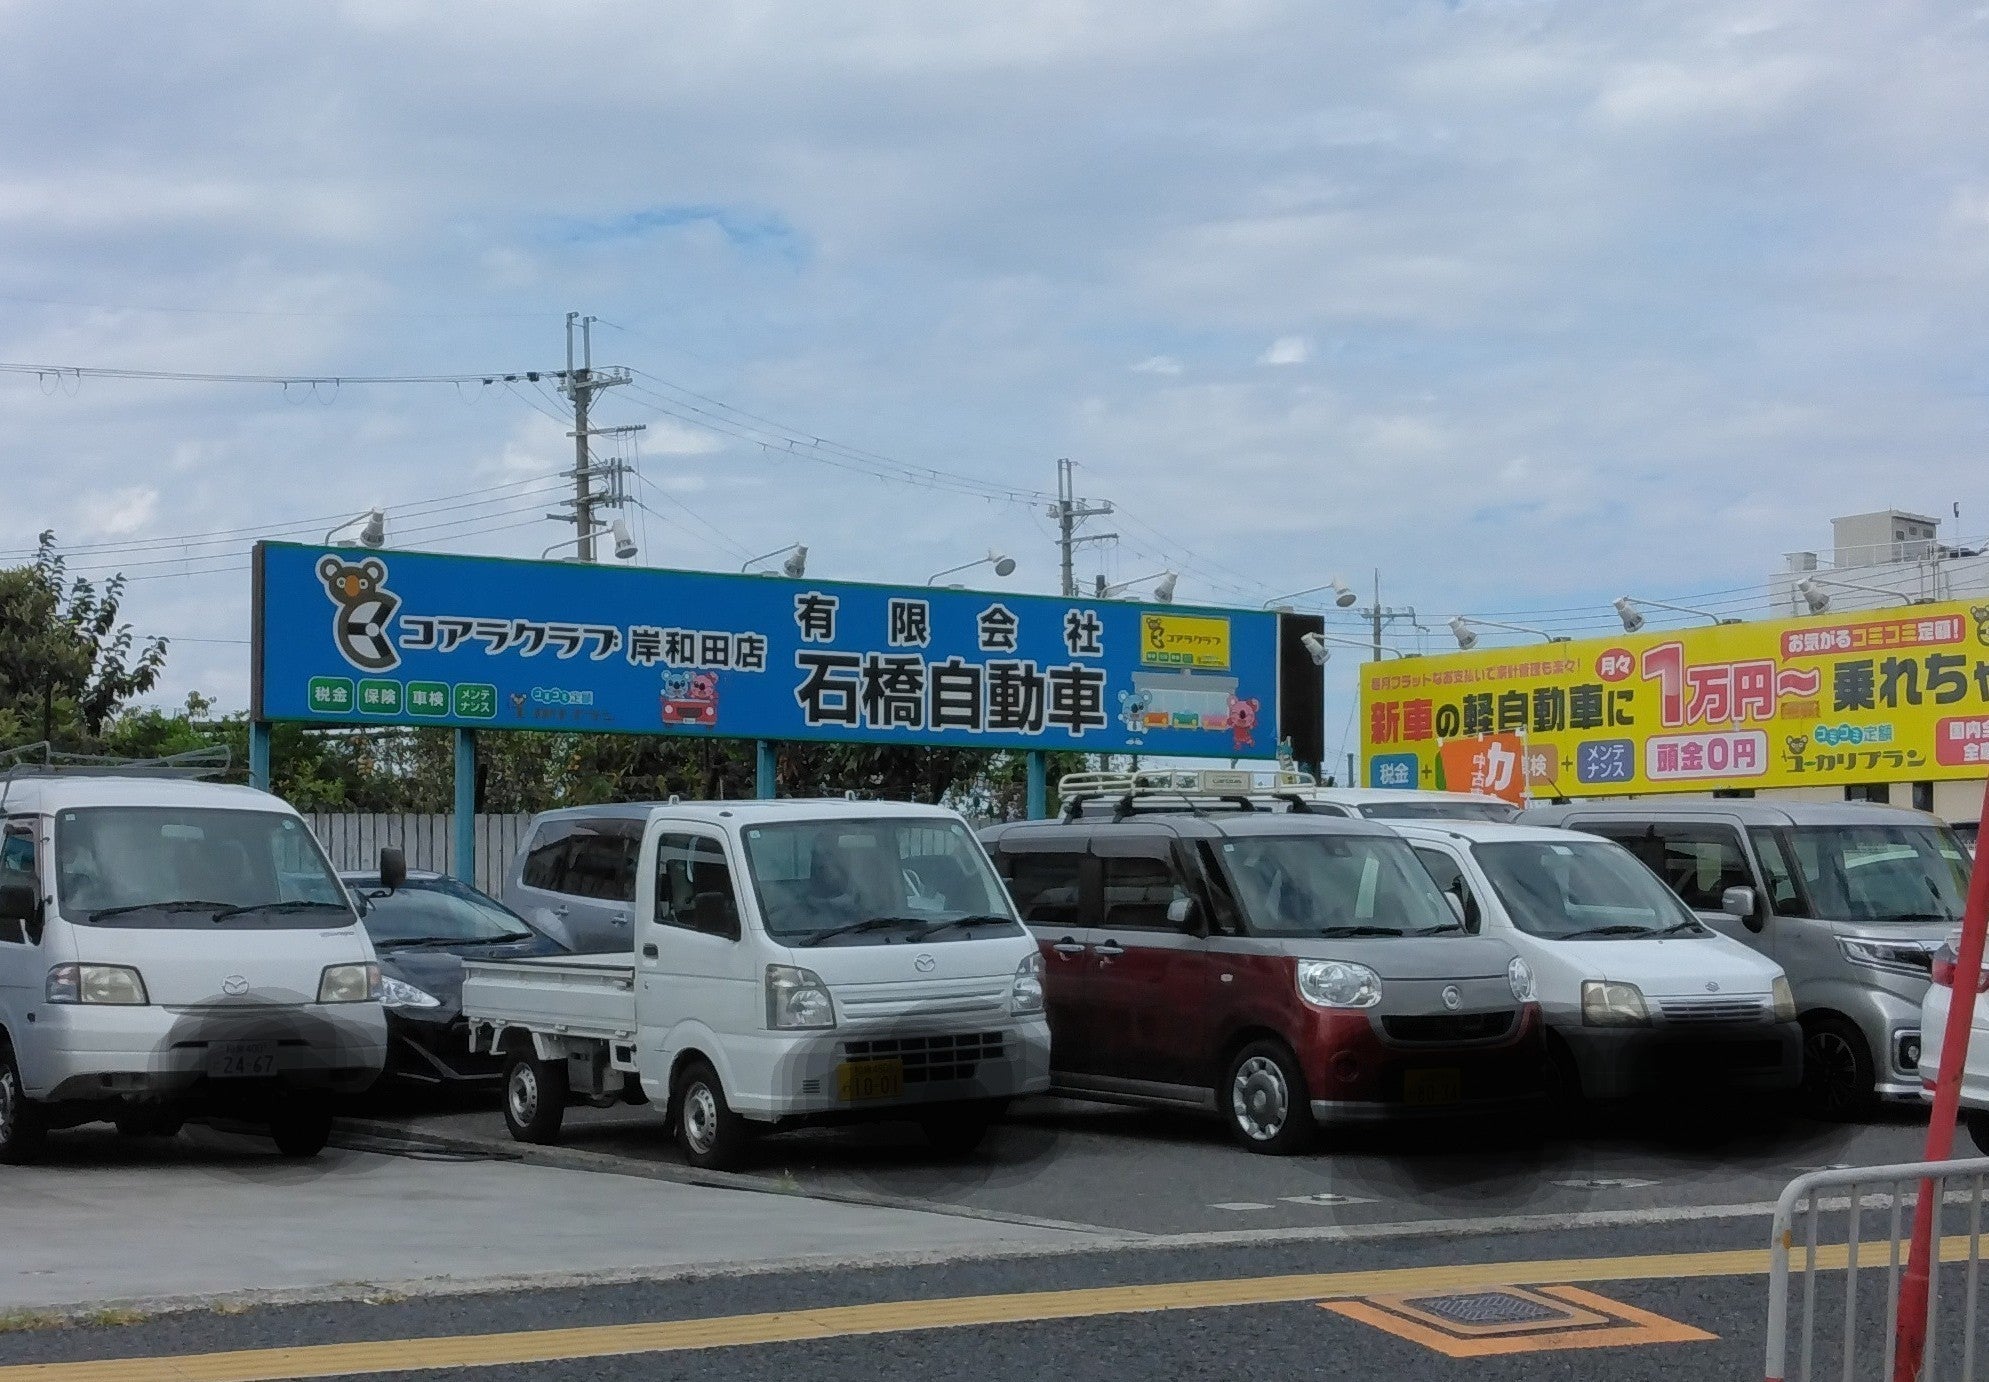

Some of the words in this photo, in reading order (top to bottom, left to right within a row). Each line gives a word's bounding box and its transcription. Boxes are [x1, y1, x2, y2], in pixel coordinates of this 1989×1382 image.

[797, 594, 1103, 655] 有限会社
[401, 619, 621, 659] コアラクラブ
[629, 627, 767, 671] 岸和田店
[1600, 655, 1632, 676] 月々
[314, 686, 348, 703] 税金
[364, 688, 396, 705] 保険
[412, 690, 444, 708] 車検
[460, 689, 491, 700] メンテ
[796, 653, 1106, 735] 石橋自動車
[460, 701, 490, 713] ナンス
[1370, 681, 1635, 745] 新車の軽自動車に
[1587, 744, 1625, 761] メンテ
[1379, 762, 1410, 785] 税金
[1587, 761, 1625, 778] ナンス
